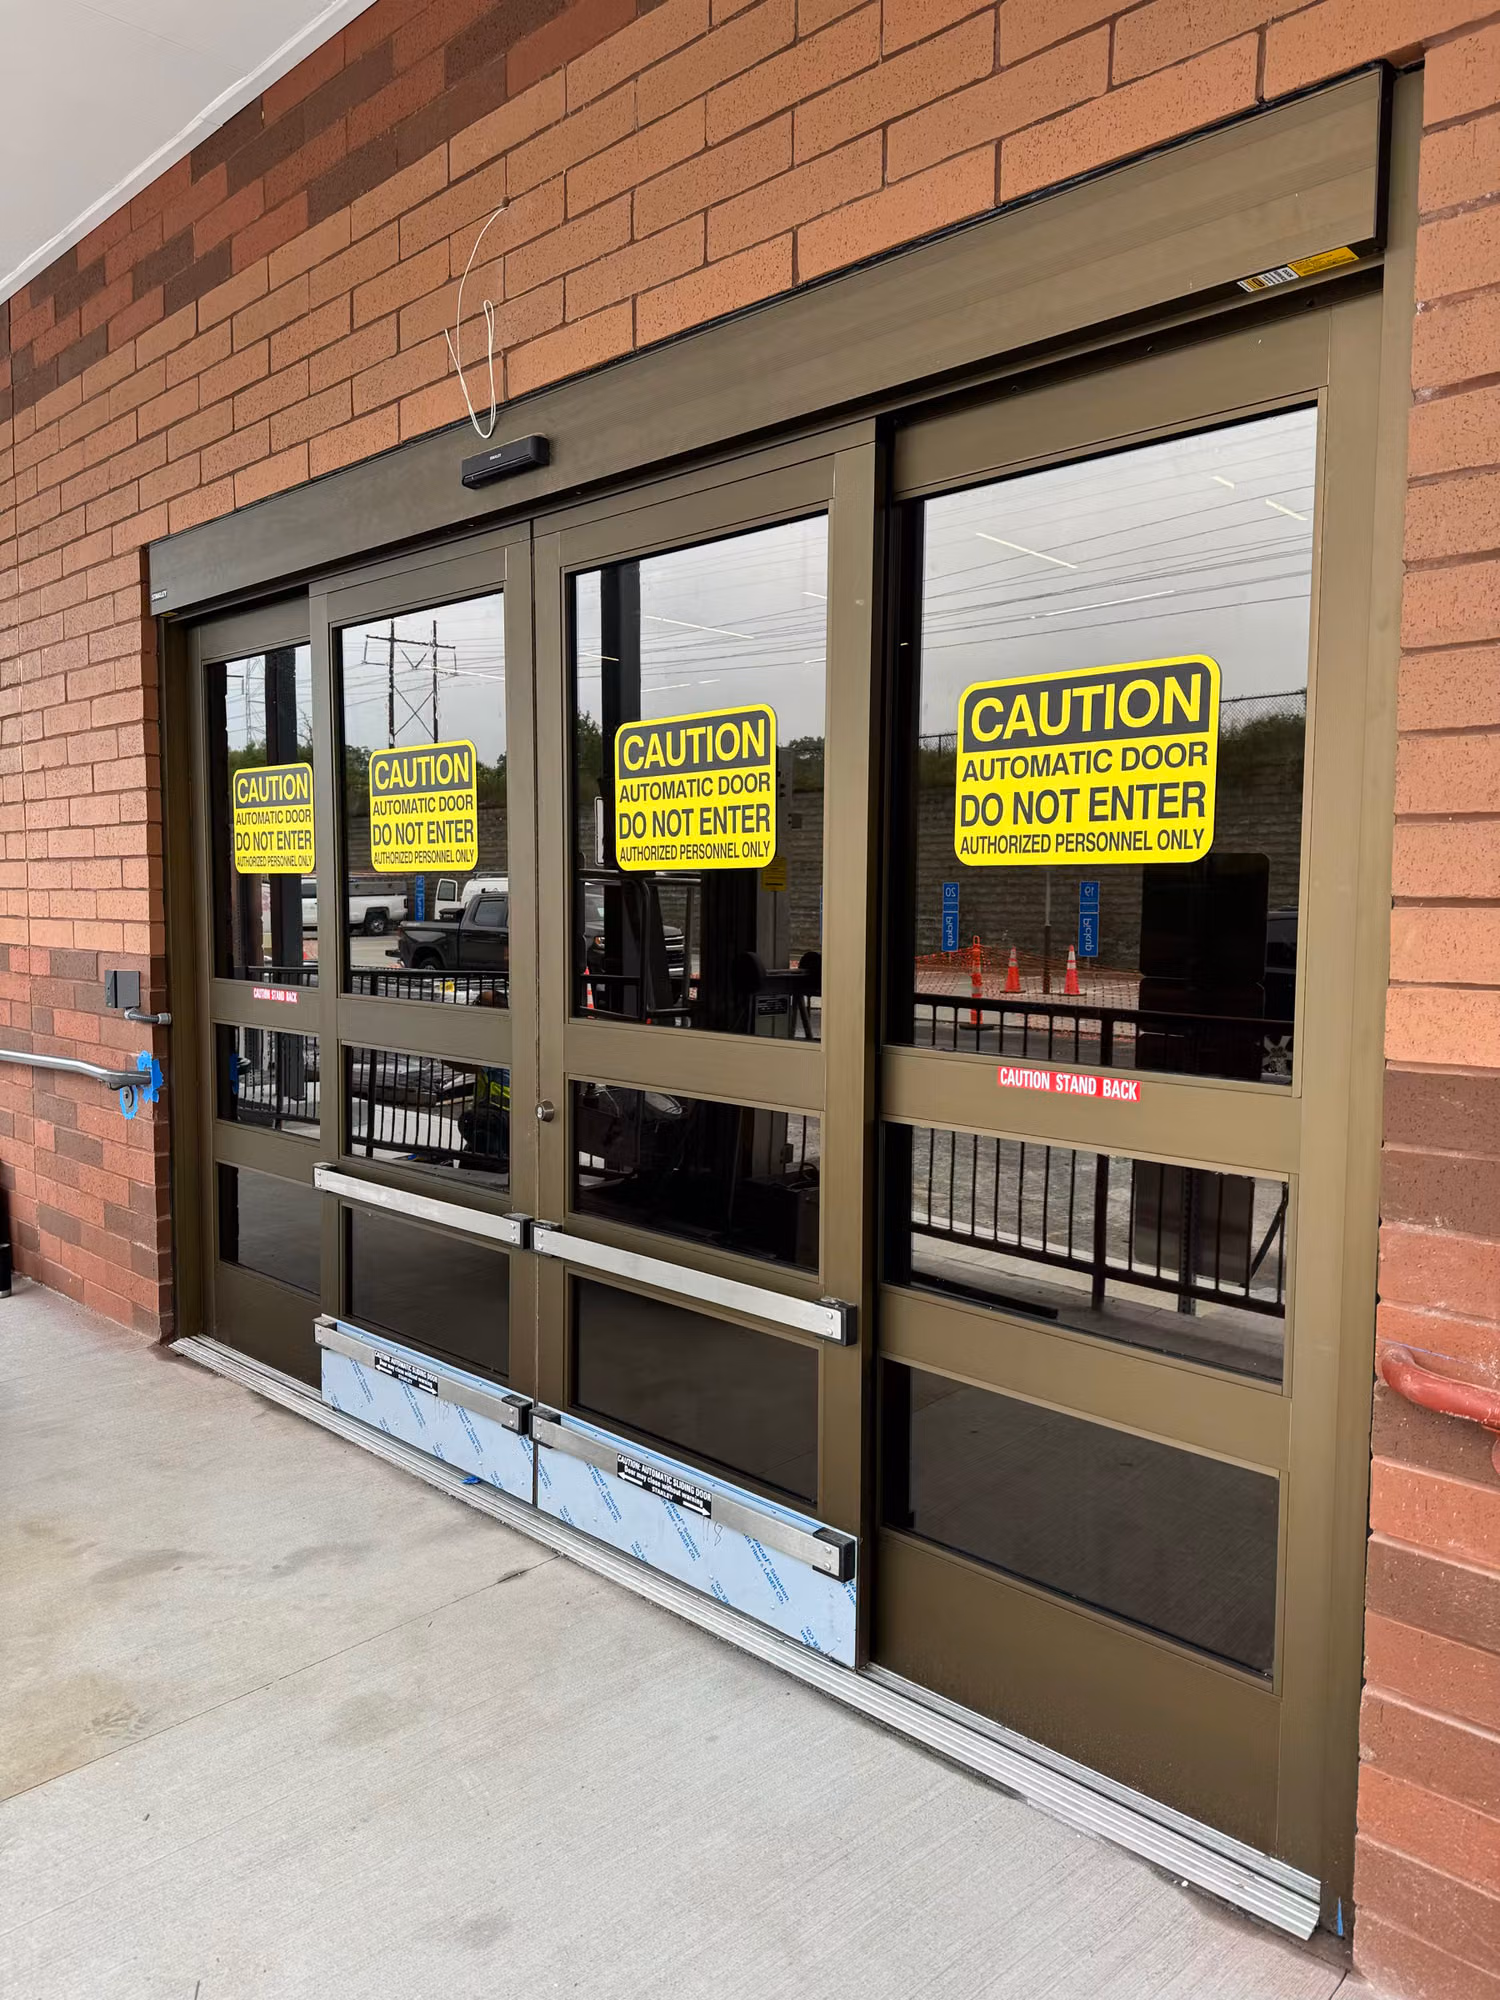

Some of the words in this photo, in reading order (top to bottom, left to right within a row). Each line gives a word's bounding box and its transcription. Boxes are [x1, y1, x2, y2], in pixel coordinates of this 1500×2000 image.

[971, 673, 1202, 742] CAUTION
[623, 718, 765, 771] CAUTION
[374, 752, 469, 790] CAUTION
[962, 748, 1113, 782] AUTOMATIC
[1121, 741, 1208, 772] DOOR
[237, 772, 308, 804] CAUTION
[619, 777, 713, 803] AUTOMATIC
[718, 772, 770, 795] DOOR
[236, 811, 284, 826] AUTOMATIC
[286, 808, 311, 823] DOOR
[373, 797, 436, 816] AUTOMATIC
[439, 794, 473, 812] DOOR
[960, 792, 1004, 827] DO
[1012, 788, 1080, 825] NOT
[1089, 781, 1206, 823] ENTER
[373, 823, 392, 846] DO
[395, 822, 423, 845] NOT
[427, 819, 474, 844] ENTER
[619, 811, 647, 840] DO
[652, 808, 694, 838] NOT
[700, 803, 770, 836] ENTER
[236, 832, 251, 851] DO
[253, 831, 274, 851] NOT
[276, 830, 312, 850] ENTER
[620, 845, 678, 862] AUTHORIZED
[679, 842, 739, 860] PERSONNEL
[742, 841, 770, 858] ONLY
[959, 834, 1051, 855] AUTHORIZED
[1055, 831, 1152, 853] PERSONNEL
[1157, 828, 1205, 850] ONLY
[237, 856, 267, 867] AUTHORIZED
[267, 856, 298, 867] PERSONNEL
[298, 855, 312, 867] ONLY
[374, 851, 413, 864] AUTHORIZED
[414, 849, 454, 864] PERSONNEL
[455, 849, 474, 863] ONLY
[253, 987, 270, 1000] CAUTION
[271, 989, 285, 1001] STAND
[286, 991, 297, 1003] BACK
[1000, 1068, 1050, 1090] CAUTION
[1055, 1073, 1097, 1095] STAND
[1102, 1079, 1137, 1100] BACK
[624, 1465, 636, 1476] Door
[636, 1472, 646, 1481] may
[647, 1476, 661, 1487] close
[662, 1484, 681, 1496] without
[682, 1492, 703, 1508] warning
[641, 1464, 672, 1484] AUTOMATIC
[673, 1478, 694, 1494] SLIDING
[695, 1488, 712, 1501] DOOR
[651, 1486, 673, 1500] STANLEY
[600, 1491, 612, 1511] LASER
[606, 1491, 622, 1520] Solution
[677, 1527, 690, 1548] LASER
[683, 1527, 701, 1558] Solution
[750, 1545, 762, 1562] Fiber
[763, 1567, 778, 1590] LASER
[769, 1568, 790, 1601] Solution
